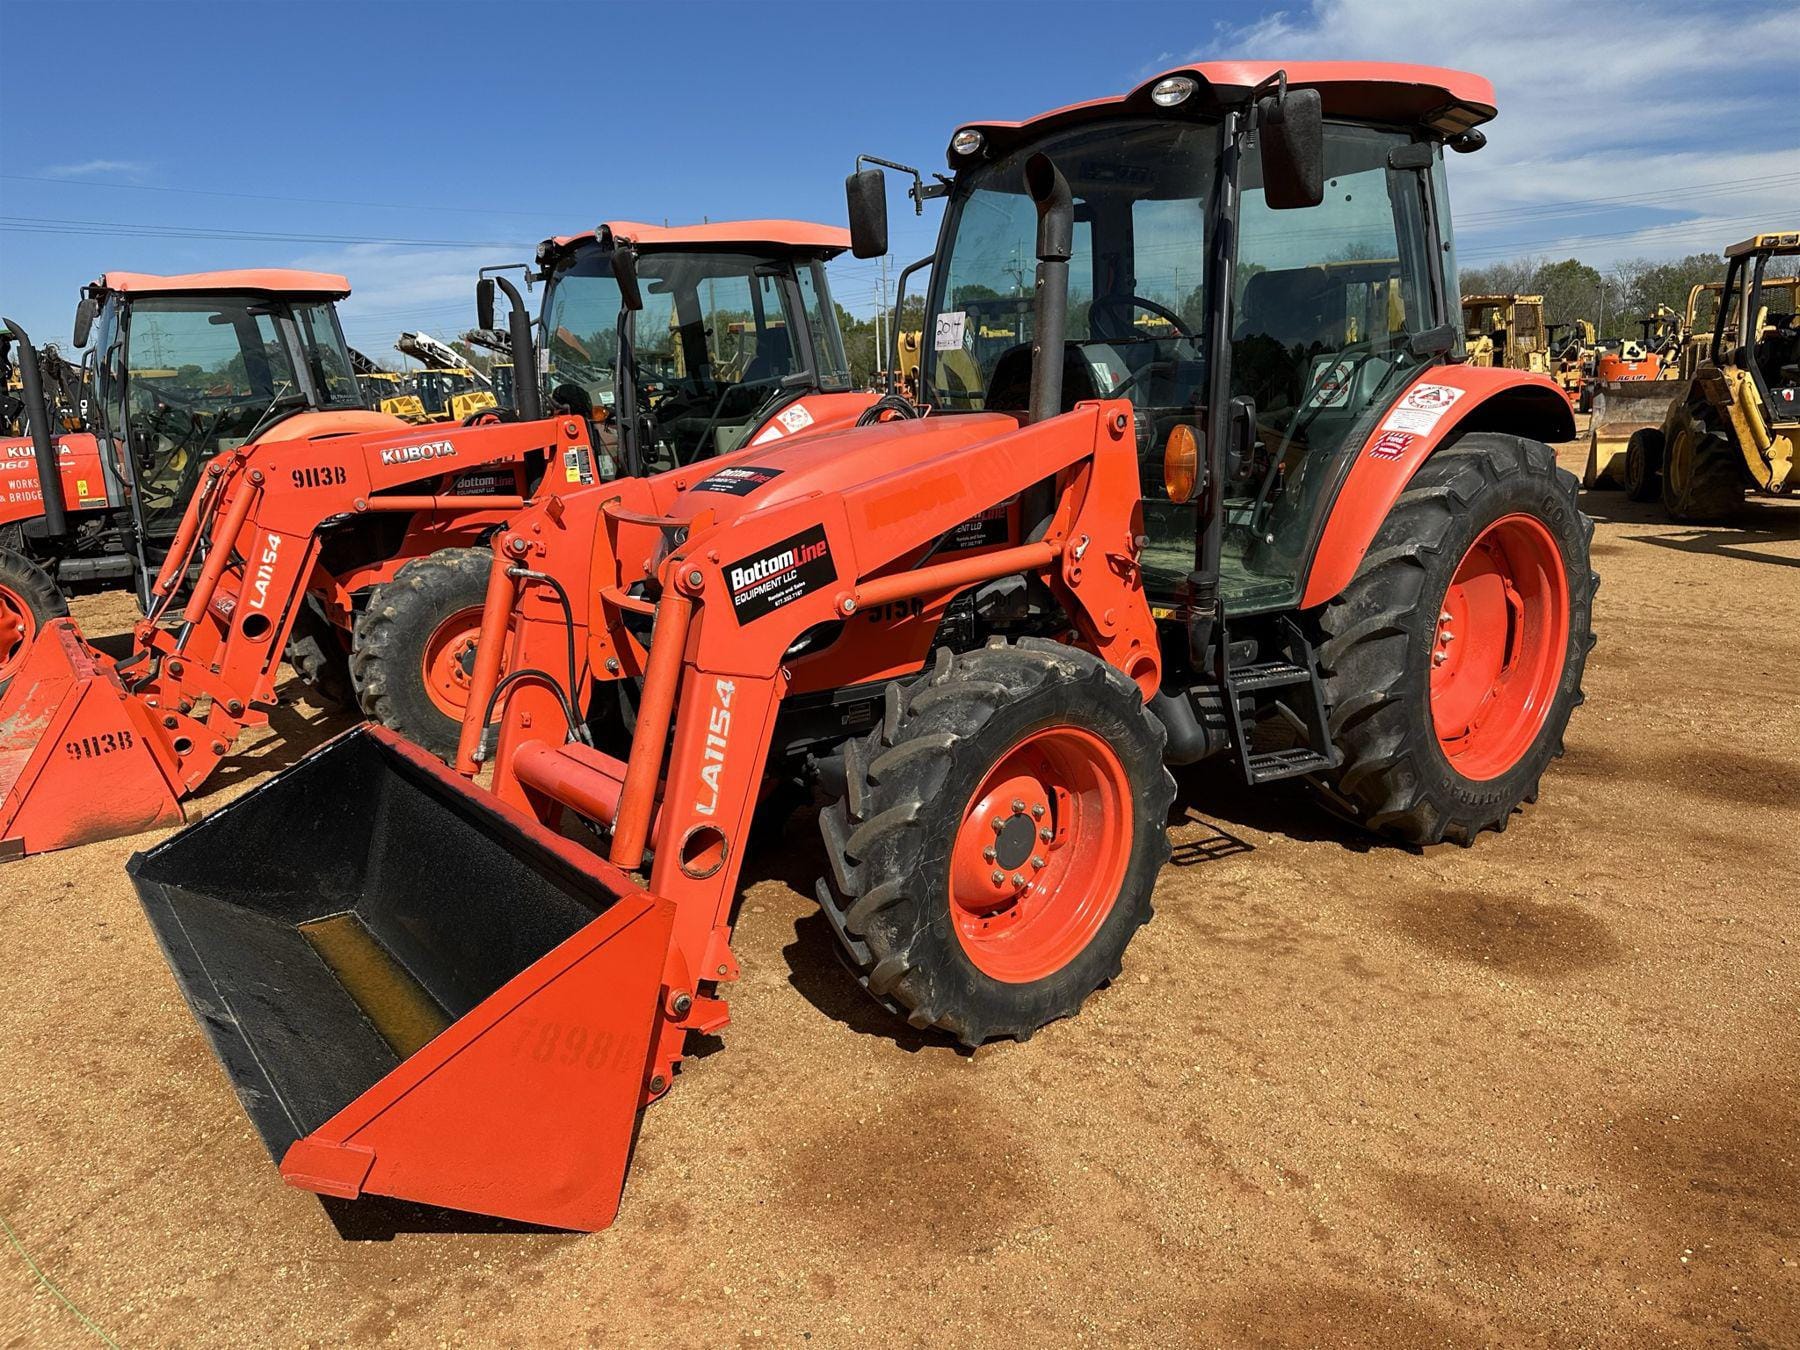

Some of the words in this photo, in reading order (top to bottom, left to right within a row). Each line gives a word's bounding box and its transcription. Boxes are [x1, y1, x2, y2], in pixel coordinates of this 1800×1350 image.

[7, 444, 72, 458] KUTA
[381, 441, 456, 466] KUBOTA
[8, 479, 39, 490] WORKS
[292, 466, 347, 489] 9113B
[9, 490, 44, 503] BRIDGE
[249, 533, 281, 609] LA1154
[734, 576, 782, 606] EQUIPMENT
[782, 569, 798, 584] LLC
[66, 731, 133, 760] 9113B
[695, 678, 736, 816] LA1154
